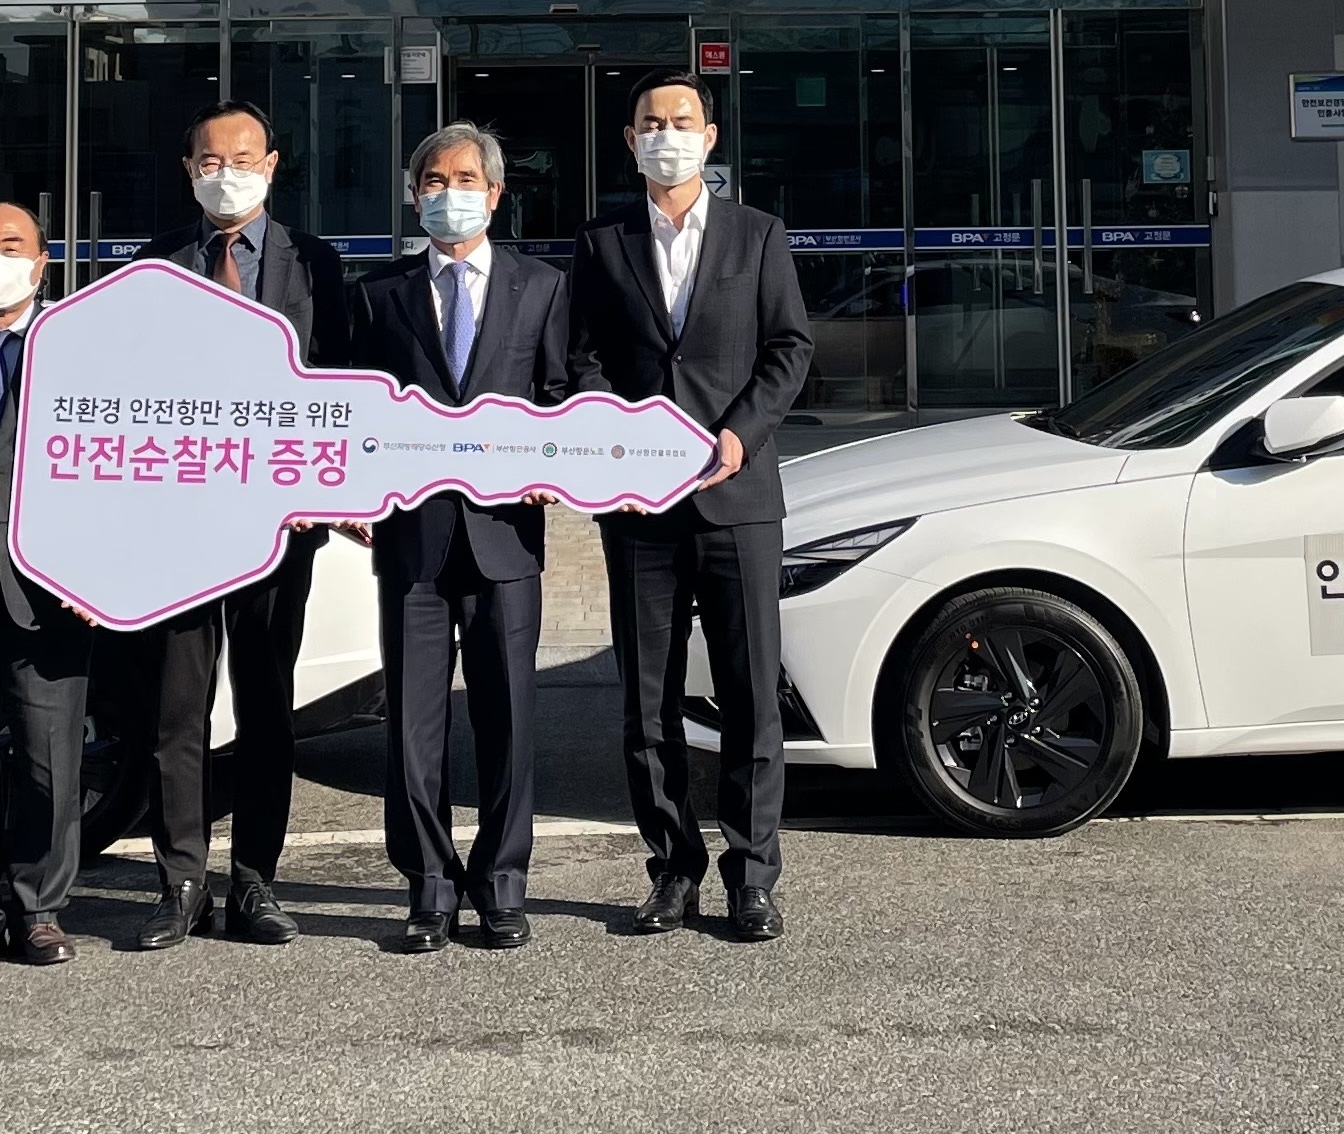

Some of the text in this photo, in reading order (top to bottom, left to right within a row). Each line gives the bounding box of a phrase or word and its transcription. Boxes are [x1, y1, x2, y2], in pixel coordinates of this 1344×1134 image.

[951, 233, 985, 243] BPA
[1101, 231, 1135, 242] BPA
[52, 396, 353, 429] 친환경 안전항만 정착을 위한
[453, 442, 485, 453] BPA
[46, 434, 349, 487] 안전순찰차 증정
